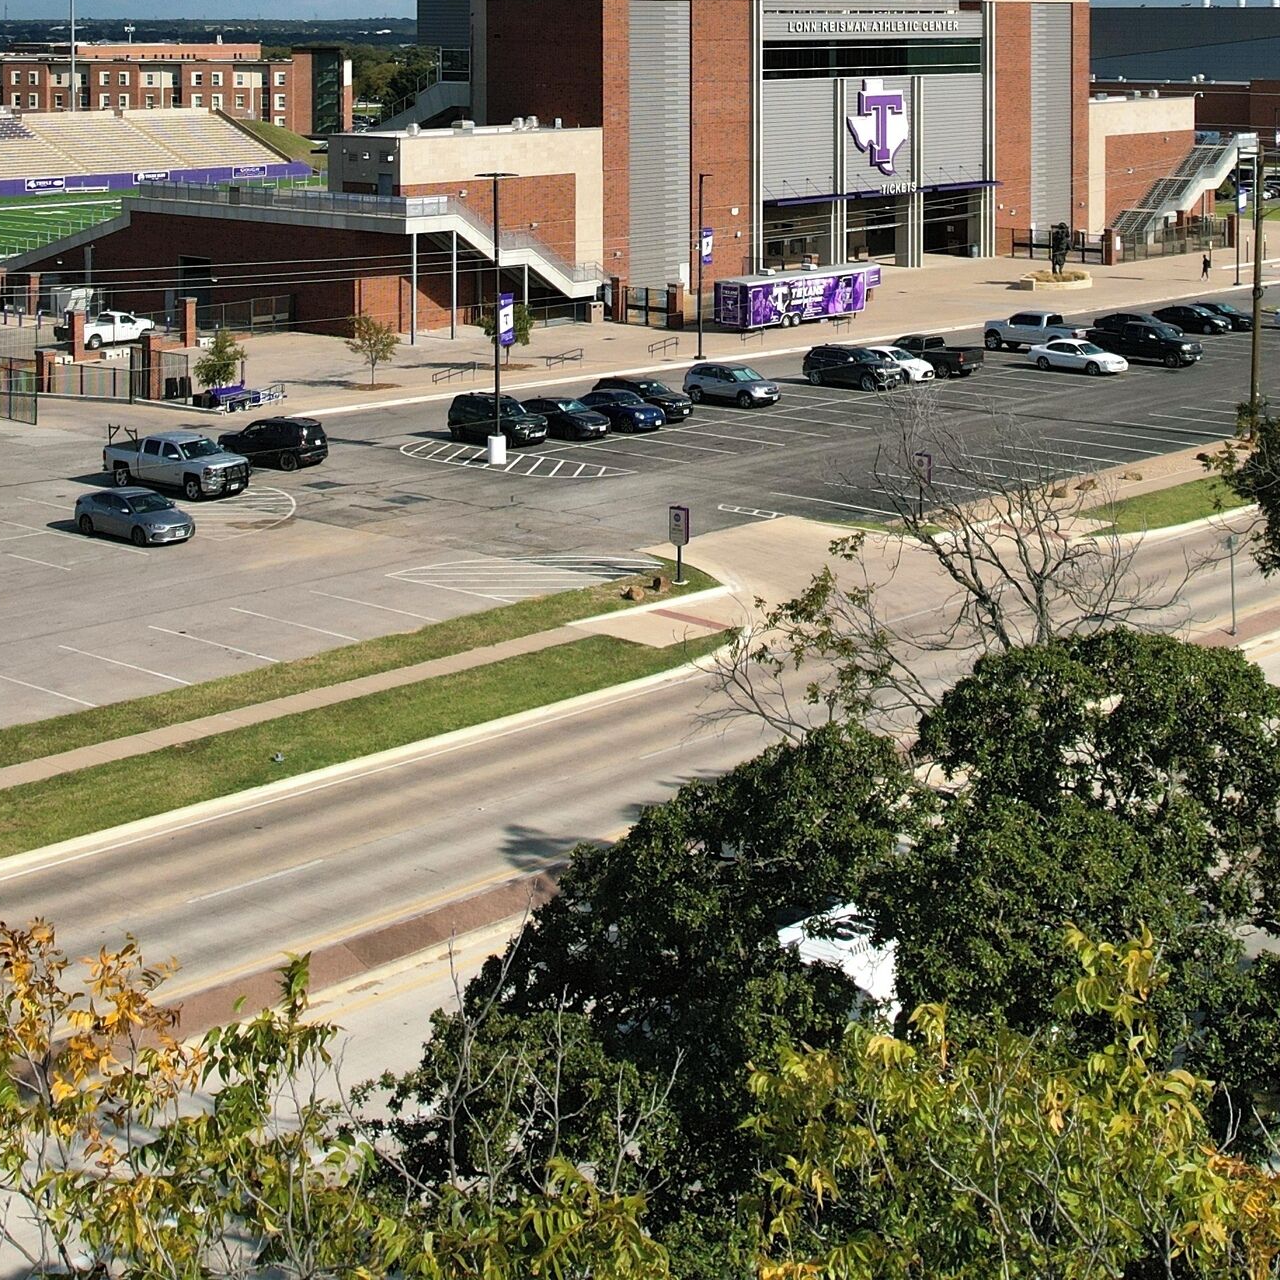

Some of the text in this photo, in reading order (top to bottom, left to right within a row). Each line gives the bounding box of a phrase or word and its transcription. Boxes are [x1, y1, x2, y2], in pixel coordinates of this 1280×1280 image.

[788, 20, 959, 33] LONN REISMAN ATHLETIC CENTER
[881, 181, 916, 194] TICKETS
